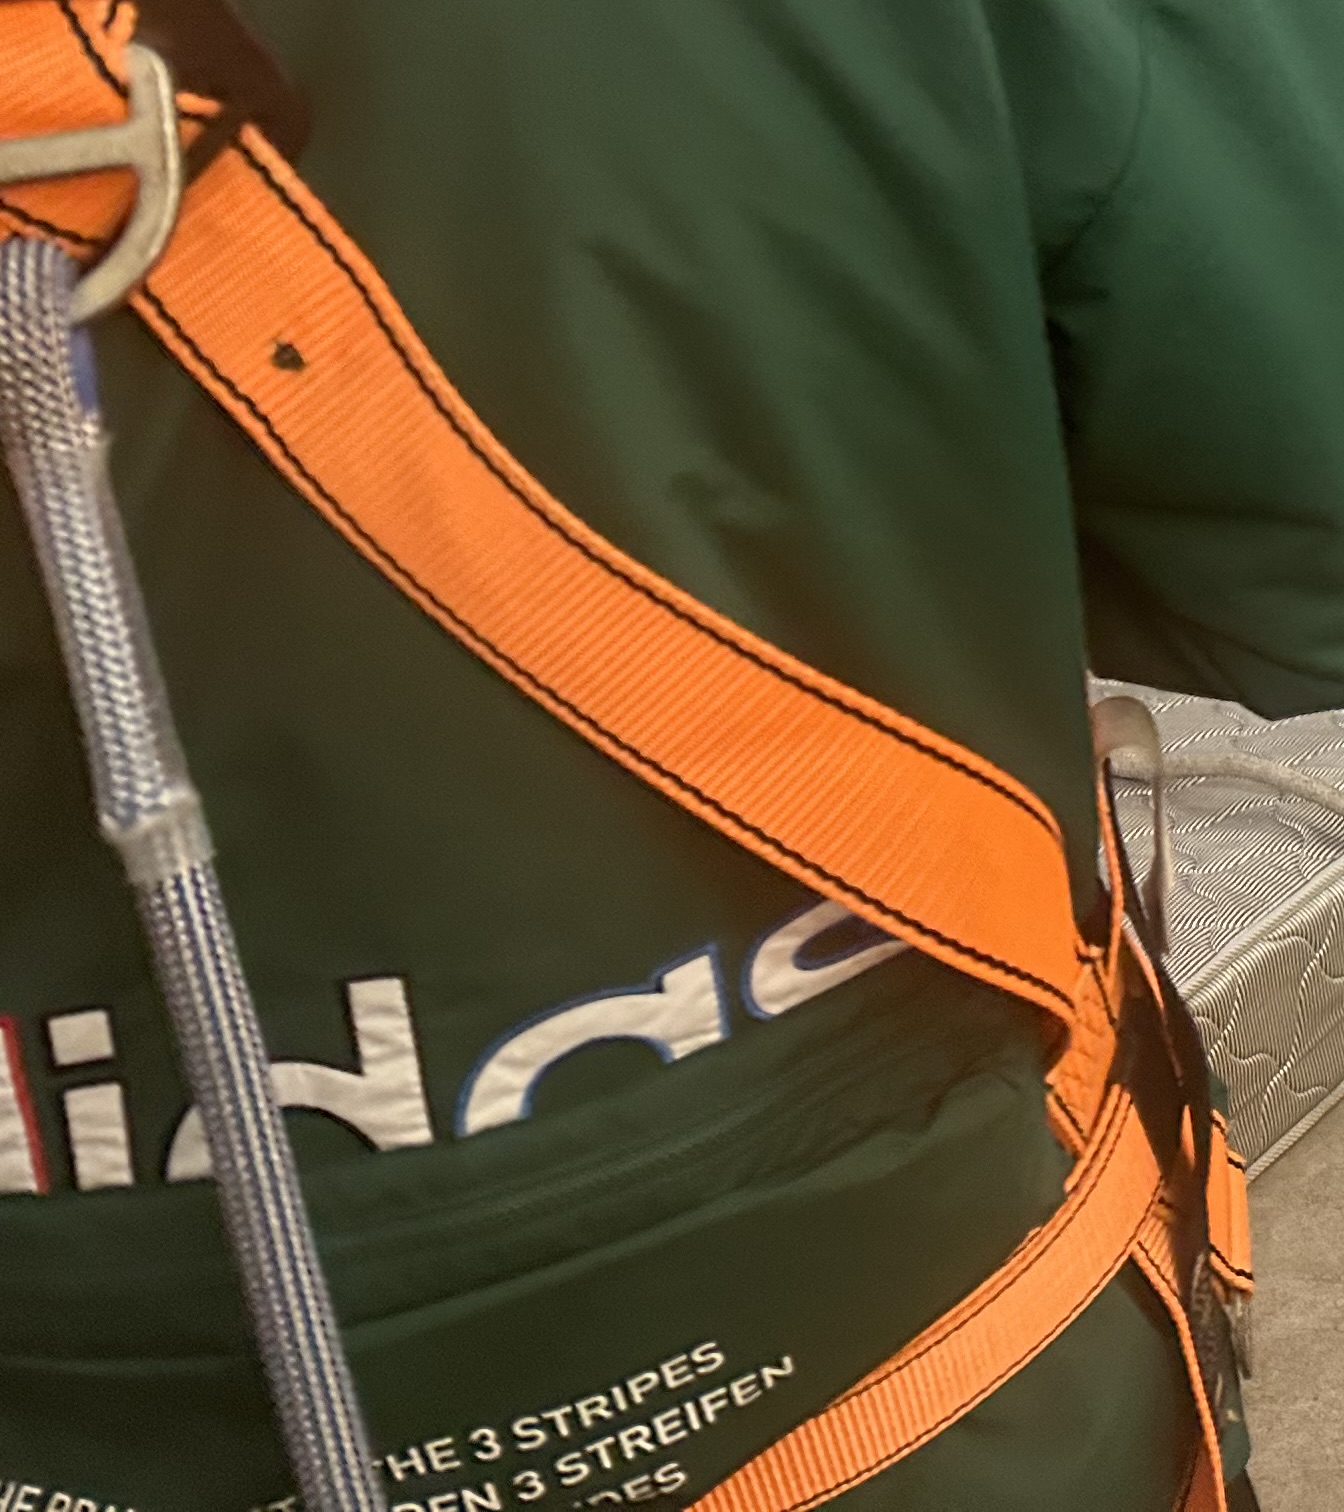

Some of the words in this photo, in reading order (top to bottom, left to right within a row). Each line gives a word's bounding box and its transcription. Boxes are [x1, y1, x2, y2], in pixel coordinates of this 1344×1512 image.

[372, 1436, 461, 1482] HE
[469, 1426, 501, 1462] 3
[511, 1341, 726, 1452] STRIPES
[513, 1469, 546, 1502] 3
[555, 1355, 795, 1487] STREIFEN
